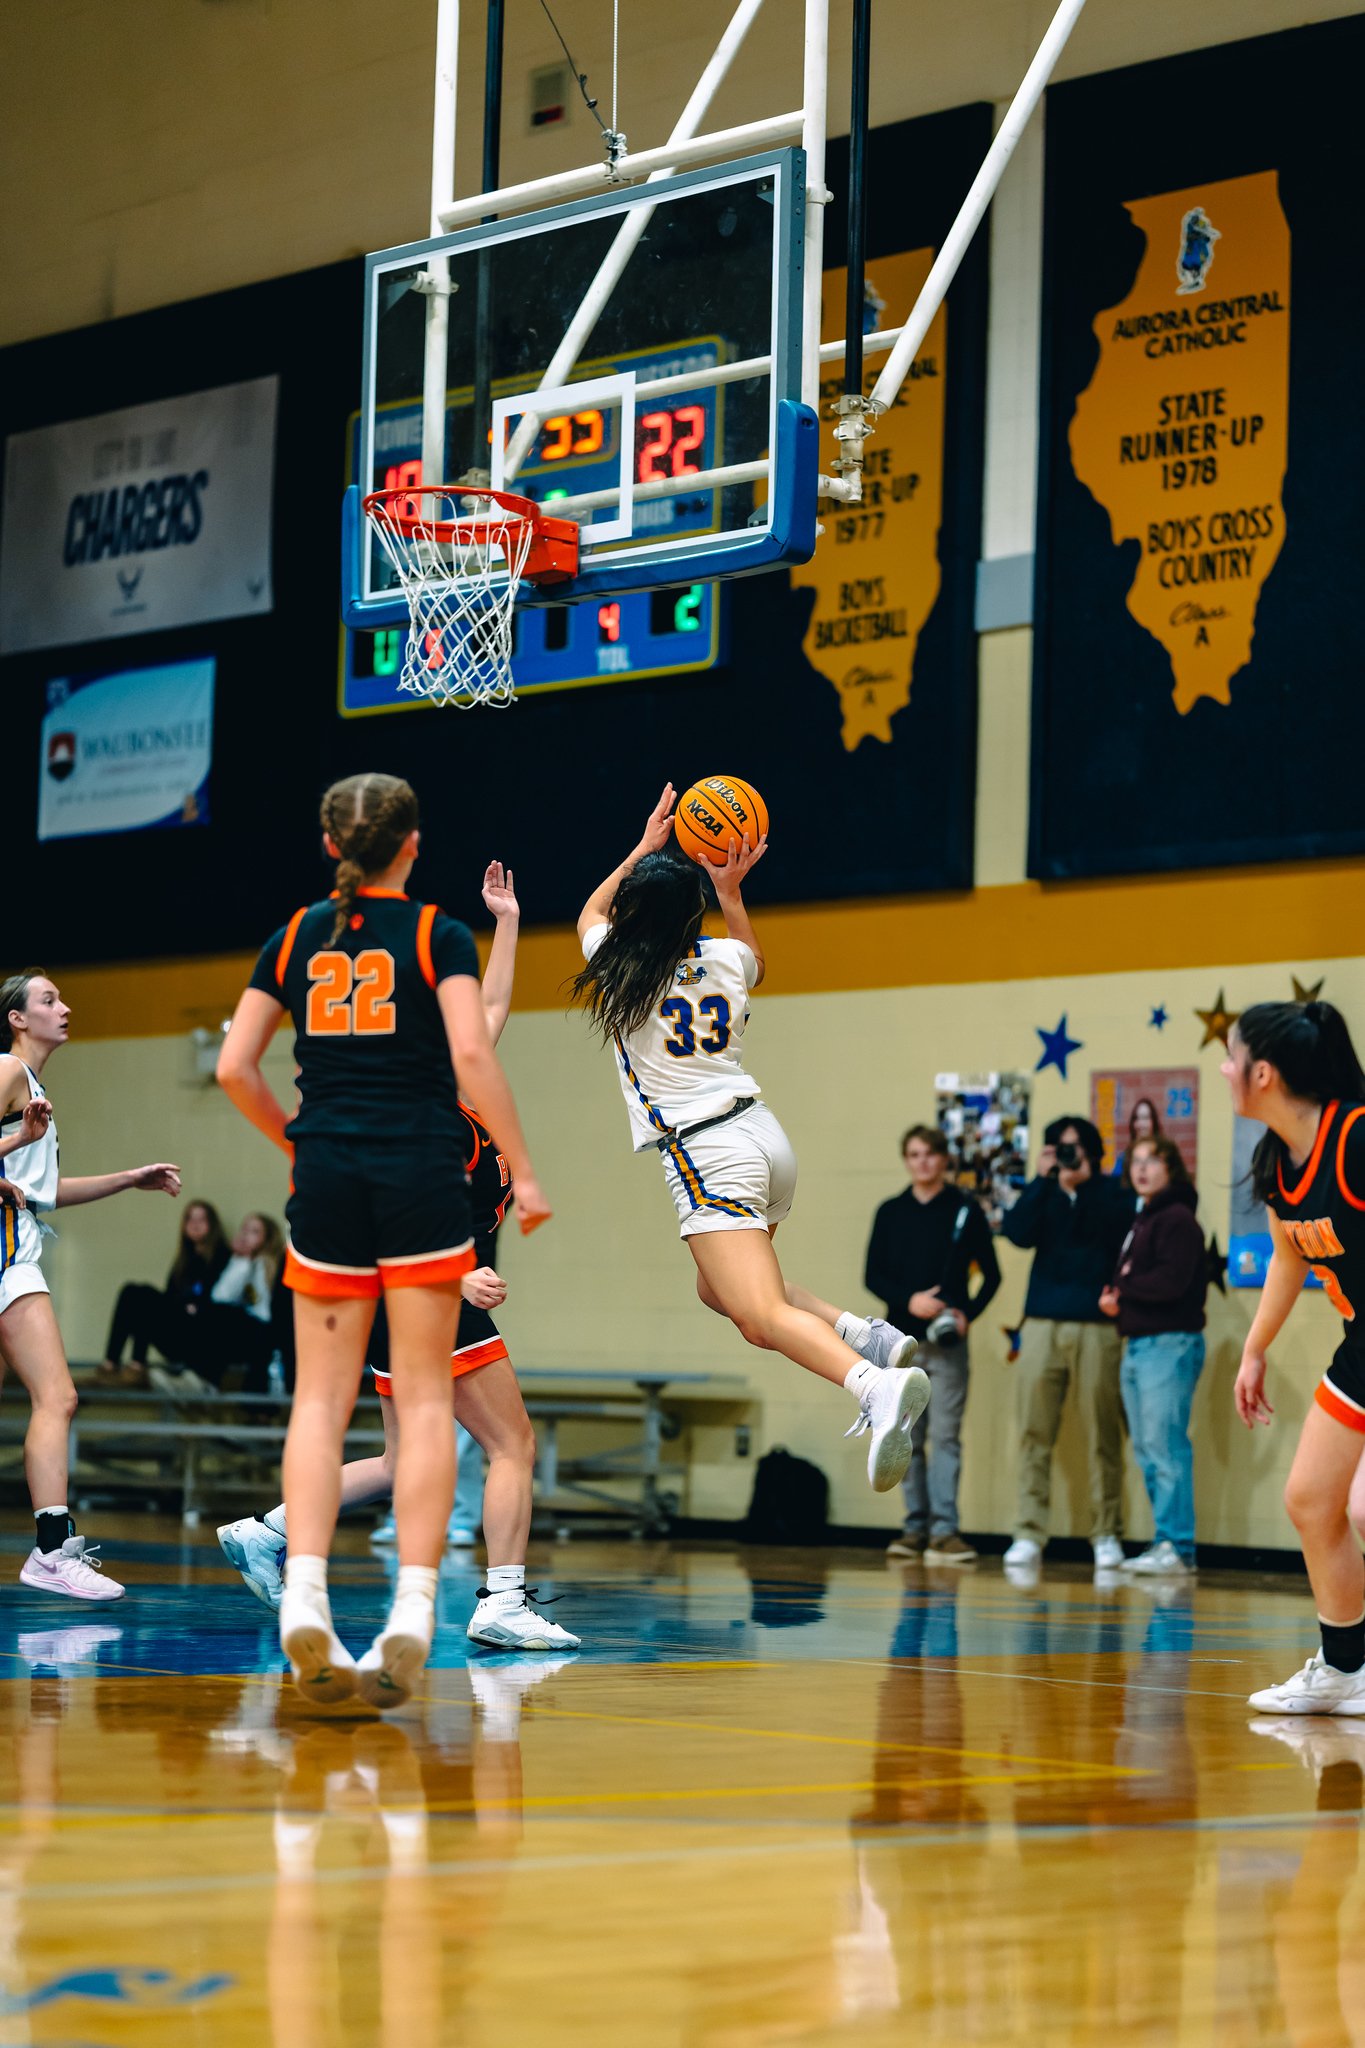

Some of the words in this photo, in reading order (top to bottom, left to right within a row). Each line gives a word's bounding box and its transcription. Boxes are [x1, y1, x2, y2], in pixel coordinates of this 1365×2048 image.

[1112, 308, 1191, 341] AURORA
[1194, 291, 1284, 324] CENTRAL
[1145, 321, 1247, 359] CATHOLIC
[1158, 387, 1226, 425] STATE
[640, 405, 706, 485] 22
[1119, 415, 1264, 464] RUNNER-UP
[1162, 456, 1217, 491] 1978
[64, 468, 209, 567] CHARGERS
[835, 511, 886, 544] 1977
[1147, 515, 1202, 554] BOYS
[1208, 504, 1274, 545] CROSS
[1158, 546, 1256, 589] COUNTRY
[598, 602, 621, 642] 4
[1194, 625, 1210, 648] A
[686, 798, 725, 837] NCAA
[704, 778, 748, 825] Wilson
[306, 948, 396, 1037] 22
[658, 993, 732, 1059] 33
[1166, 1087, 1193, 1118] 25
